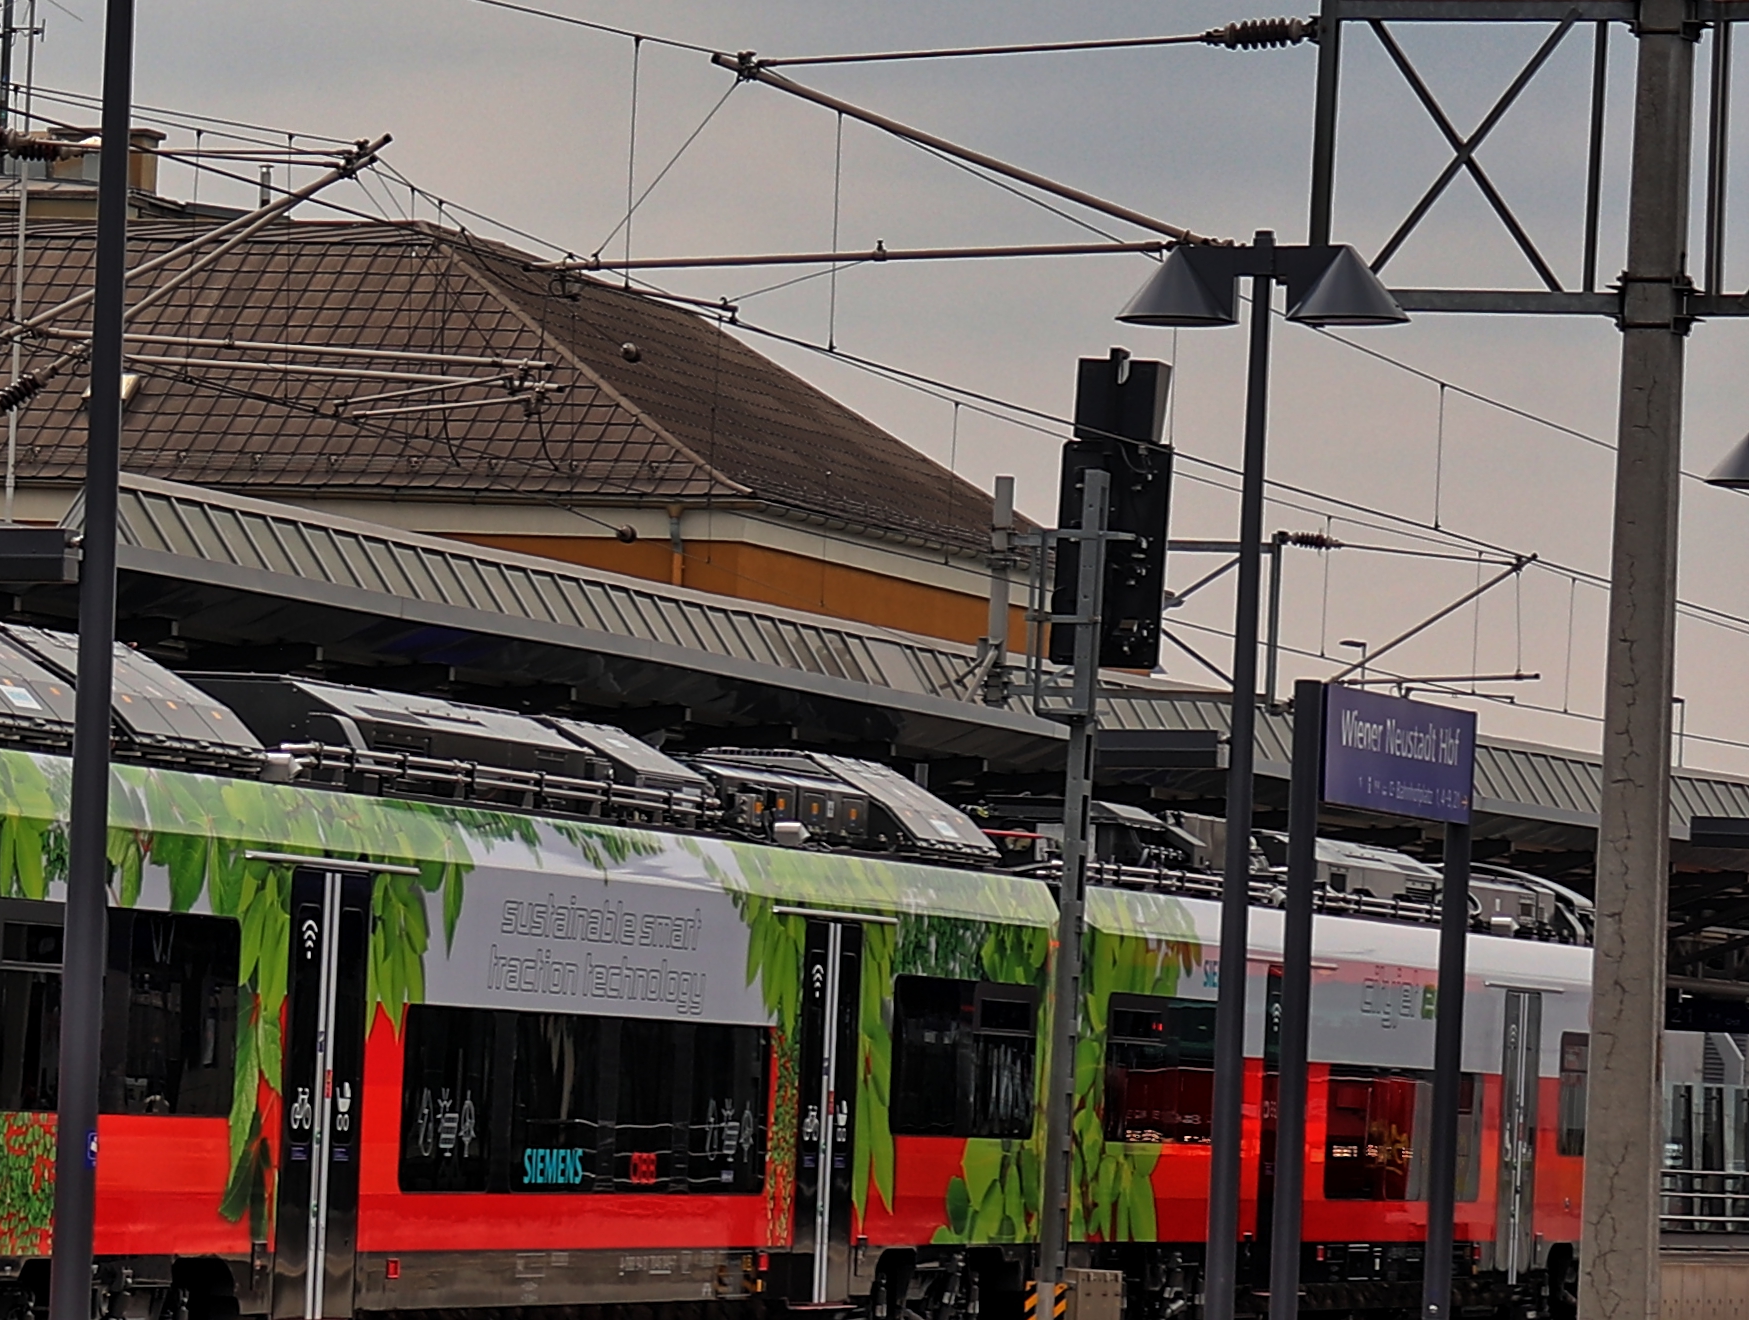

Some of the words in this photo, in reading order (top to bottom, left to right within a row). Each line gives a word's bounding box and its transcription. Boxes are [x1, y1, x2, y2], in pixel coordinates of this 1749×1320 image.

[1341, 708, 1383, 753] Wiener
[1385, 718, 1437, 763] Neustadt
[1438, 726, 1461, 767] Hbf
[501, 893, 637, 946] sustainable
[638, 908, 702, 951] smart
[487, 944, 578, 996] traction
[582, 952, 706, 1015] technology
[523, 1148, 583, 1184] SIEMENS
